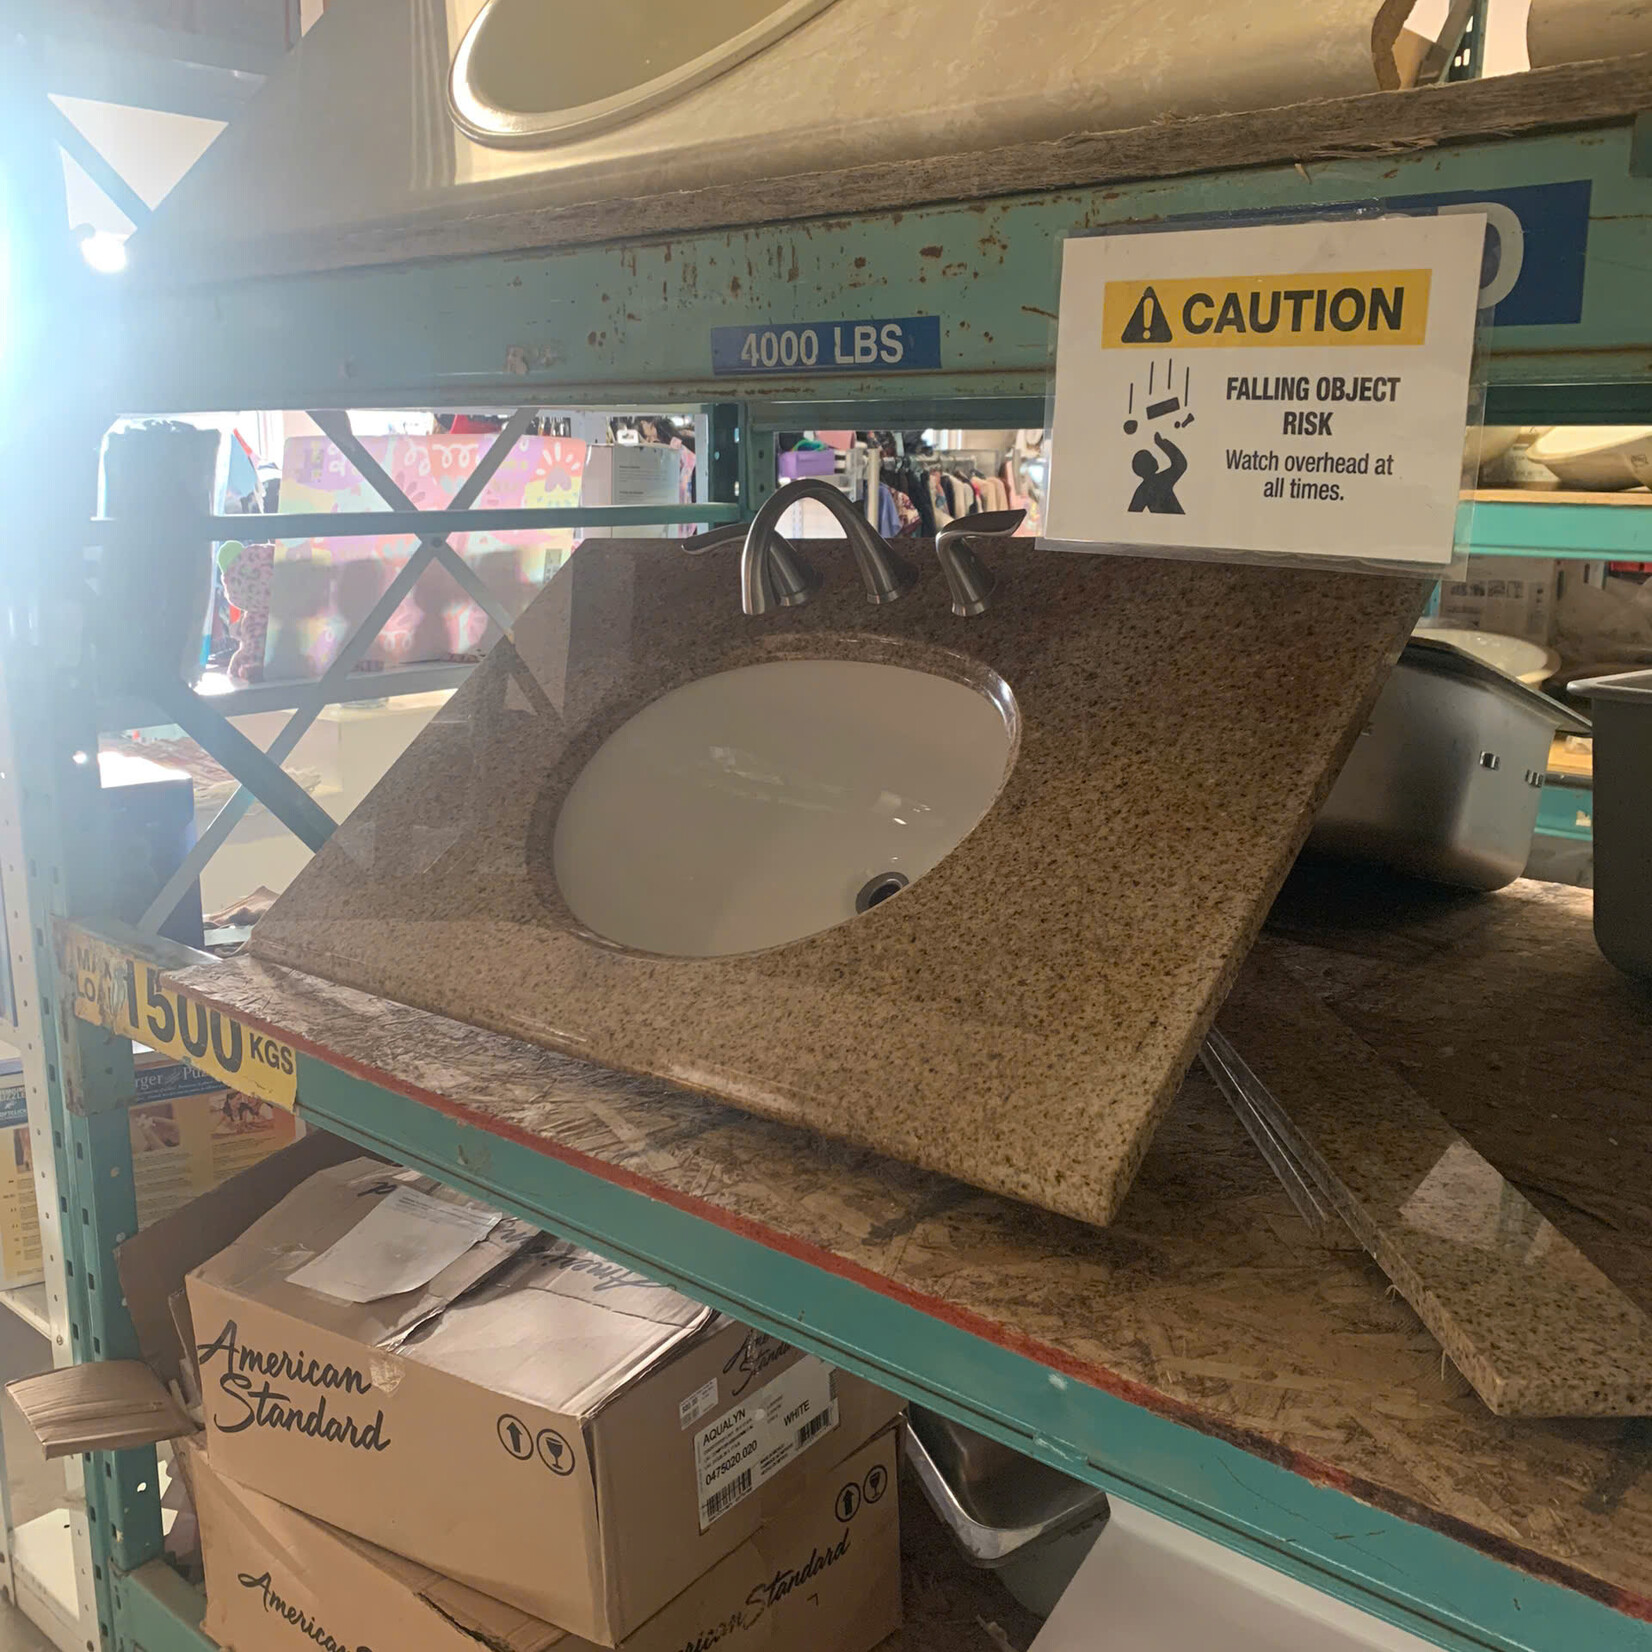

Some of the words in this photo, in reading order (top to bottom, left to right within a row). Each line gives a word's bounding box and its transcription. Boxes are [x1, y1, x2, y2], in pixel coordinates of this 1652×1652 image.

[1182, 287, 1405, 335] CAUTION
[741, 329, 819, 367] 4000
[834, 323, 904, 364] LBS
[1226, 377, 1310, 401] FALLING
[1316, 377, 1401, 402] OBJECT
[1283, 411, 1334, 436] RISK
[1226, 449, 1279, 471] Watch
[1284, 452, 1370, 475] overhead
[1374, 454, 1395, 475] at
[1263, 477, 1285, 498] all
[1290, 479, 1345, 501] times.
[124, 959, 244, 1074] 1500
[249, 1031, 295, 1076] KGS
[197, 1319, 372, 1395] American
[213, 1372, 392, 1452] Standard
[703, 1408, 747, 1447] AQUALYN
[783, 1399, 811, 1427] WHITE
[745, 1527, 851, 1631] Standard
